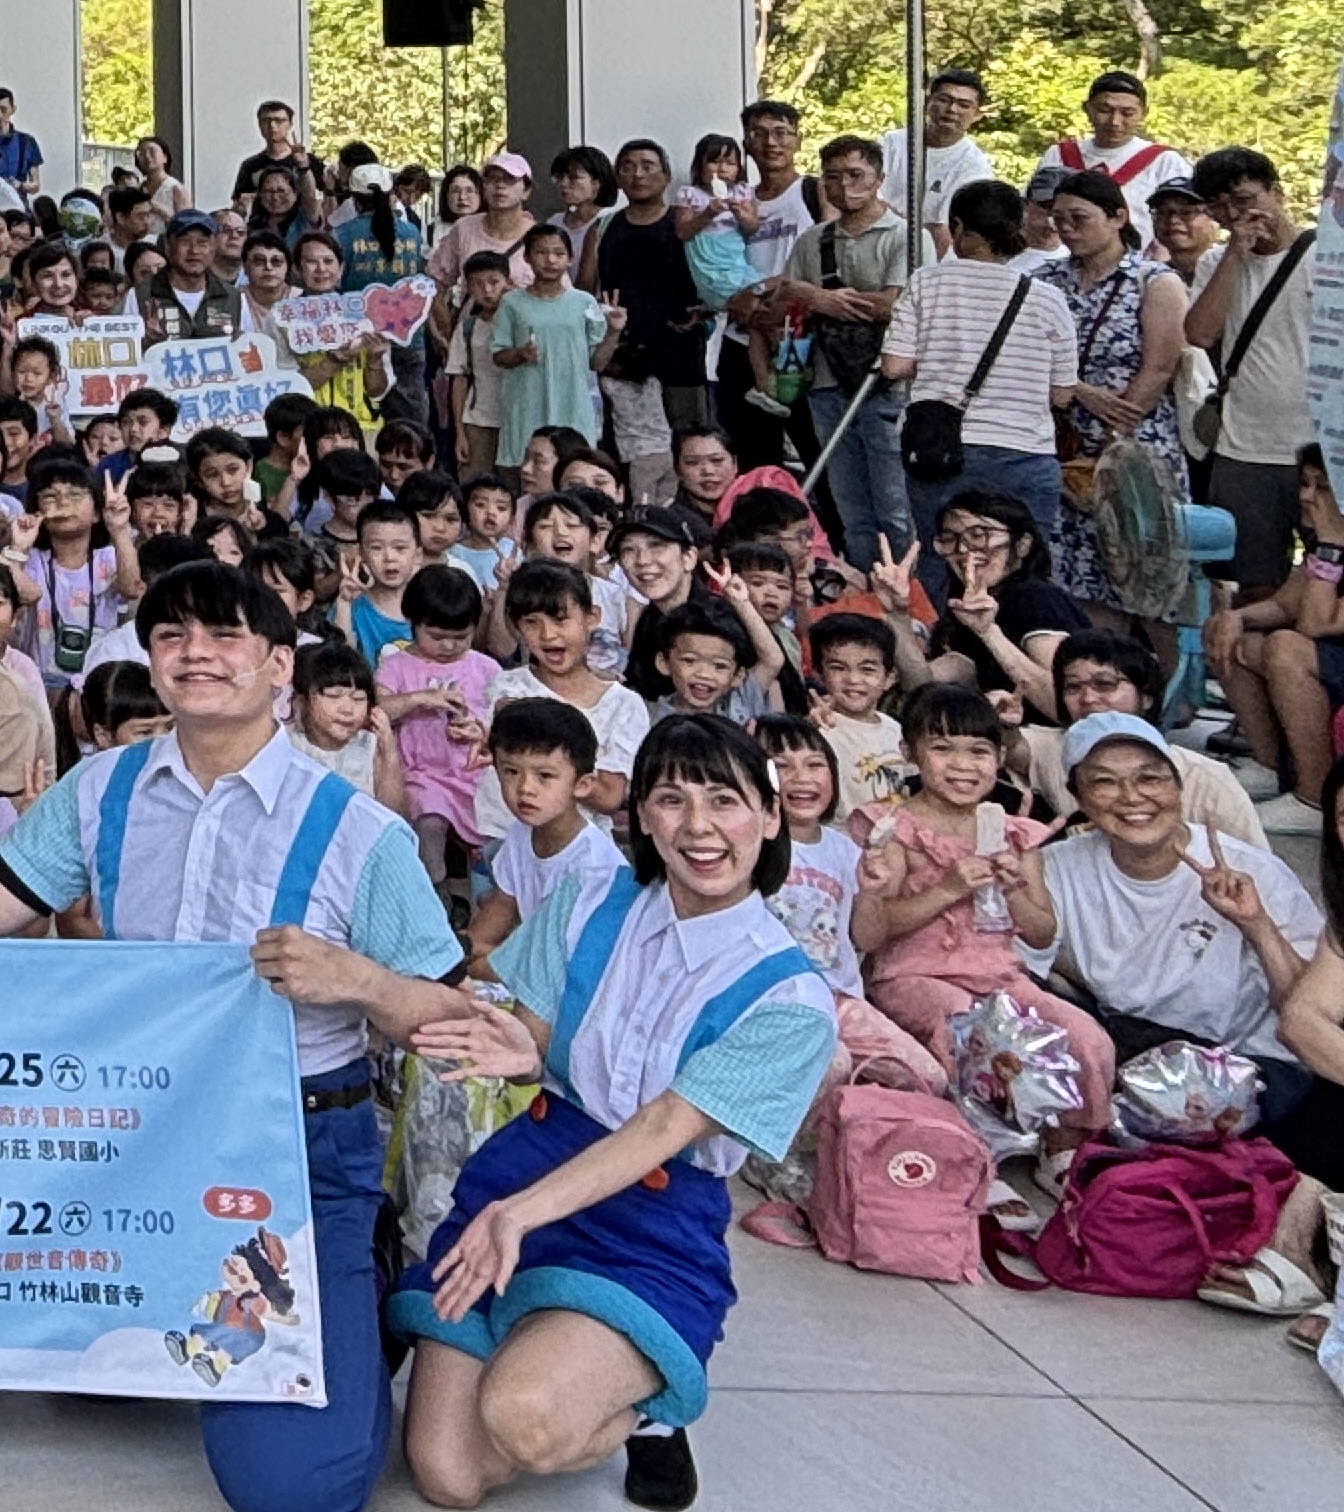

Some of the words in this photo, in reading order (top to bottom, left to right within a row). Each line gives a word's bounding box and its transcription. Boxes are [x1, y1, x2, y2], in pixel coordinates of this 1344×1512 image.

[67, 337, 138, 369] 林口
[161, 345, 233, 377] 林口
[98, 1065, 171, 1090] 17:00
[103, 1209, 174, 1234] 17:00
